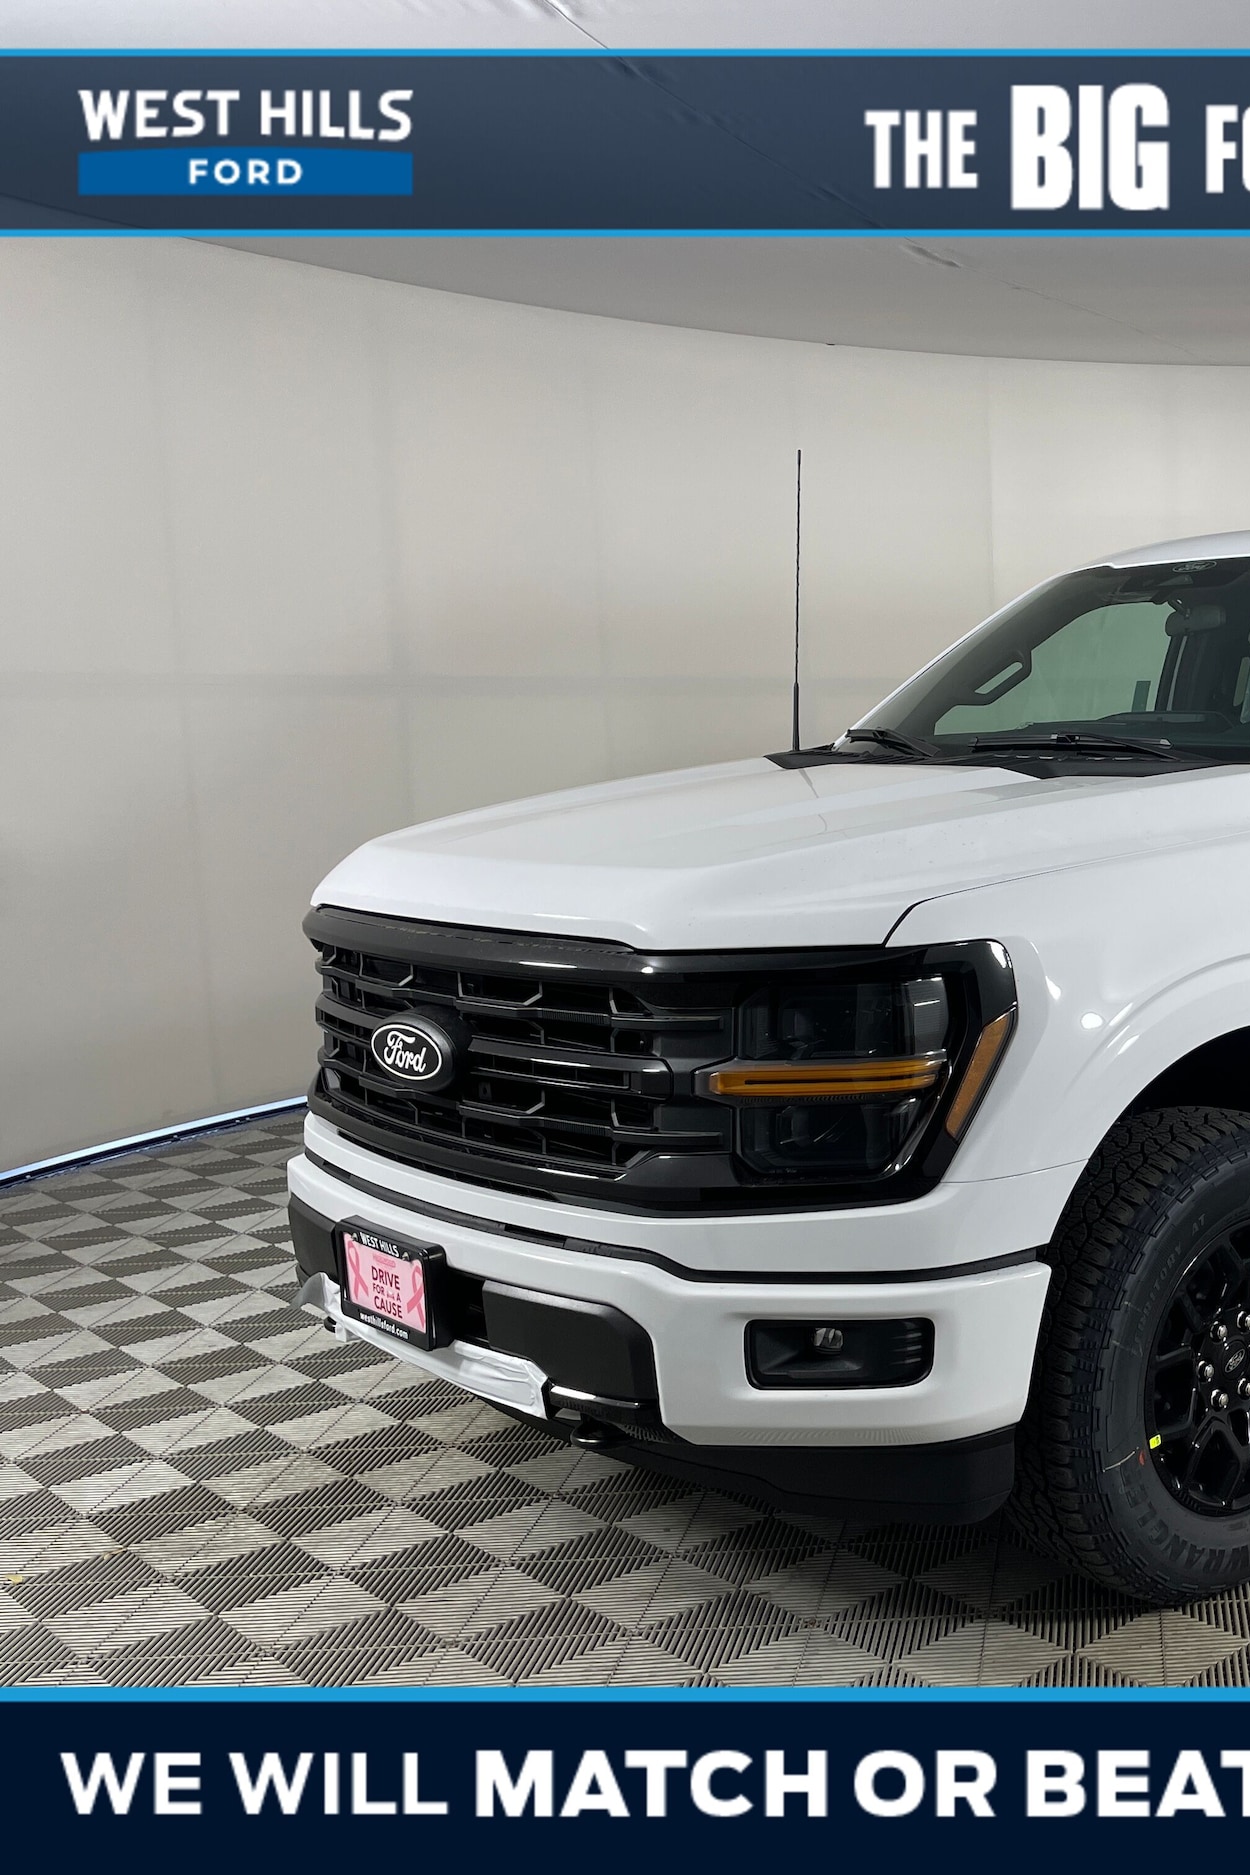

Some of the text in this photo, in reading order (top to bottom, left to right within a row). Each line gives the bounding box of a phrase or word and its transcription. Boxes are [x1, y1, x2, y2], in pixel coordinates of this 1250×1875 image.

[383, 1030, 427, 1073] Ford
[359, 1231, 400, 1258] WEST HILLS
[371, 1265, 401, 1291] DRIVE
[372, 1282, 402, 1303] FOR A
[374, 1295, 403, 1319] CAUSE
[359, 1312, 409, 1340] westhillsford.com
